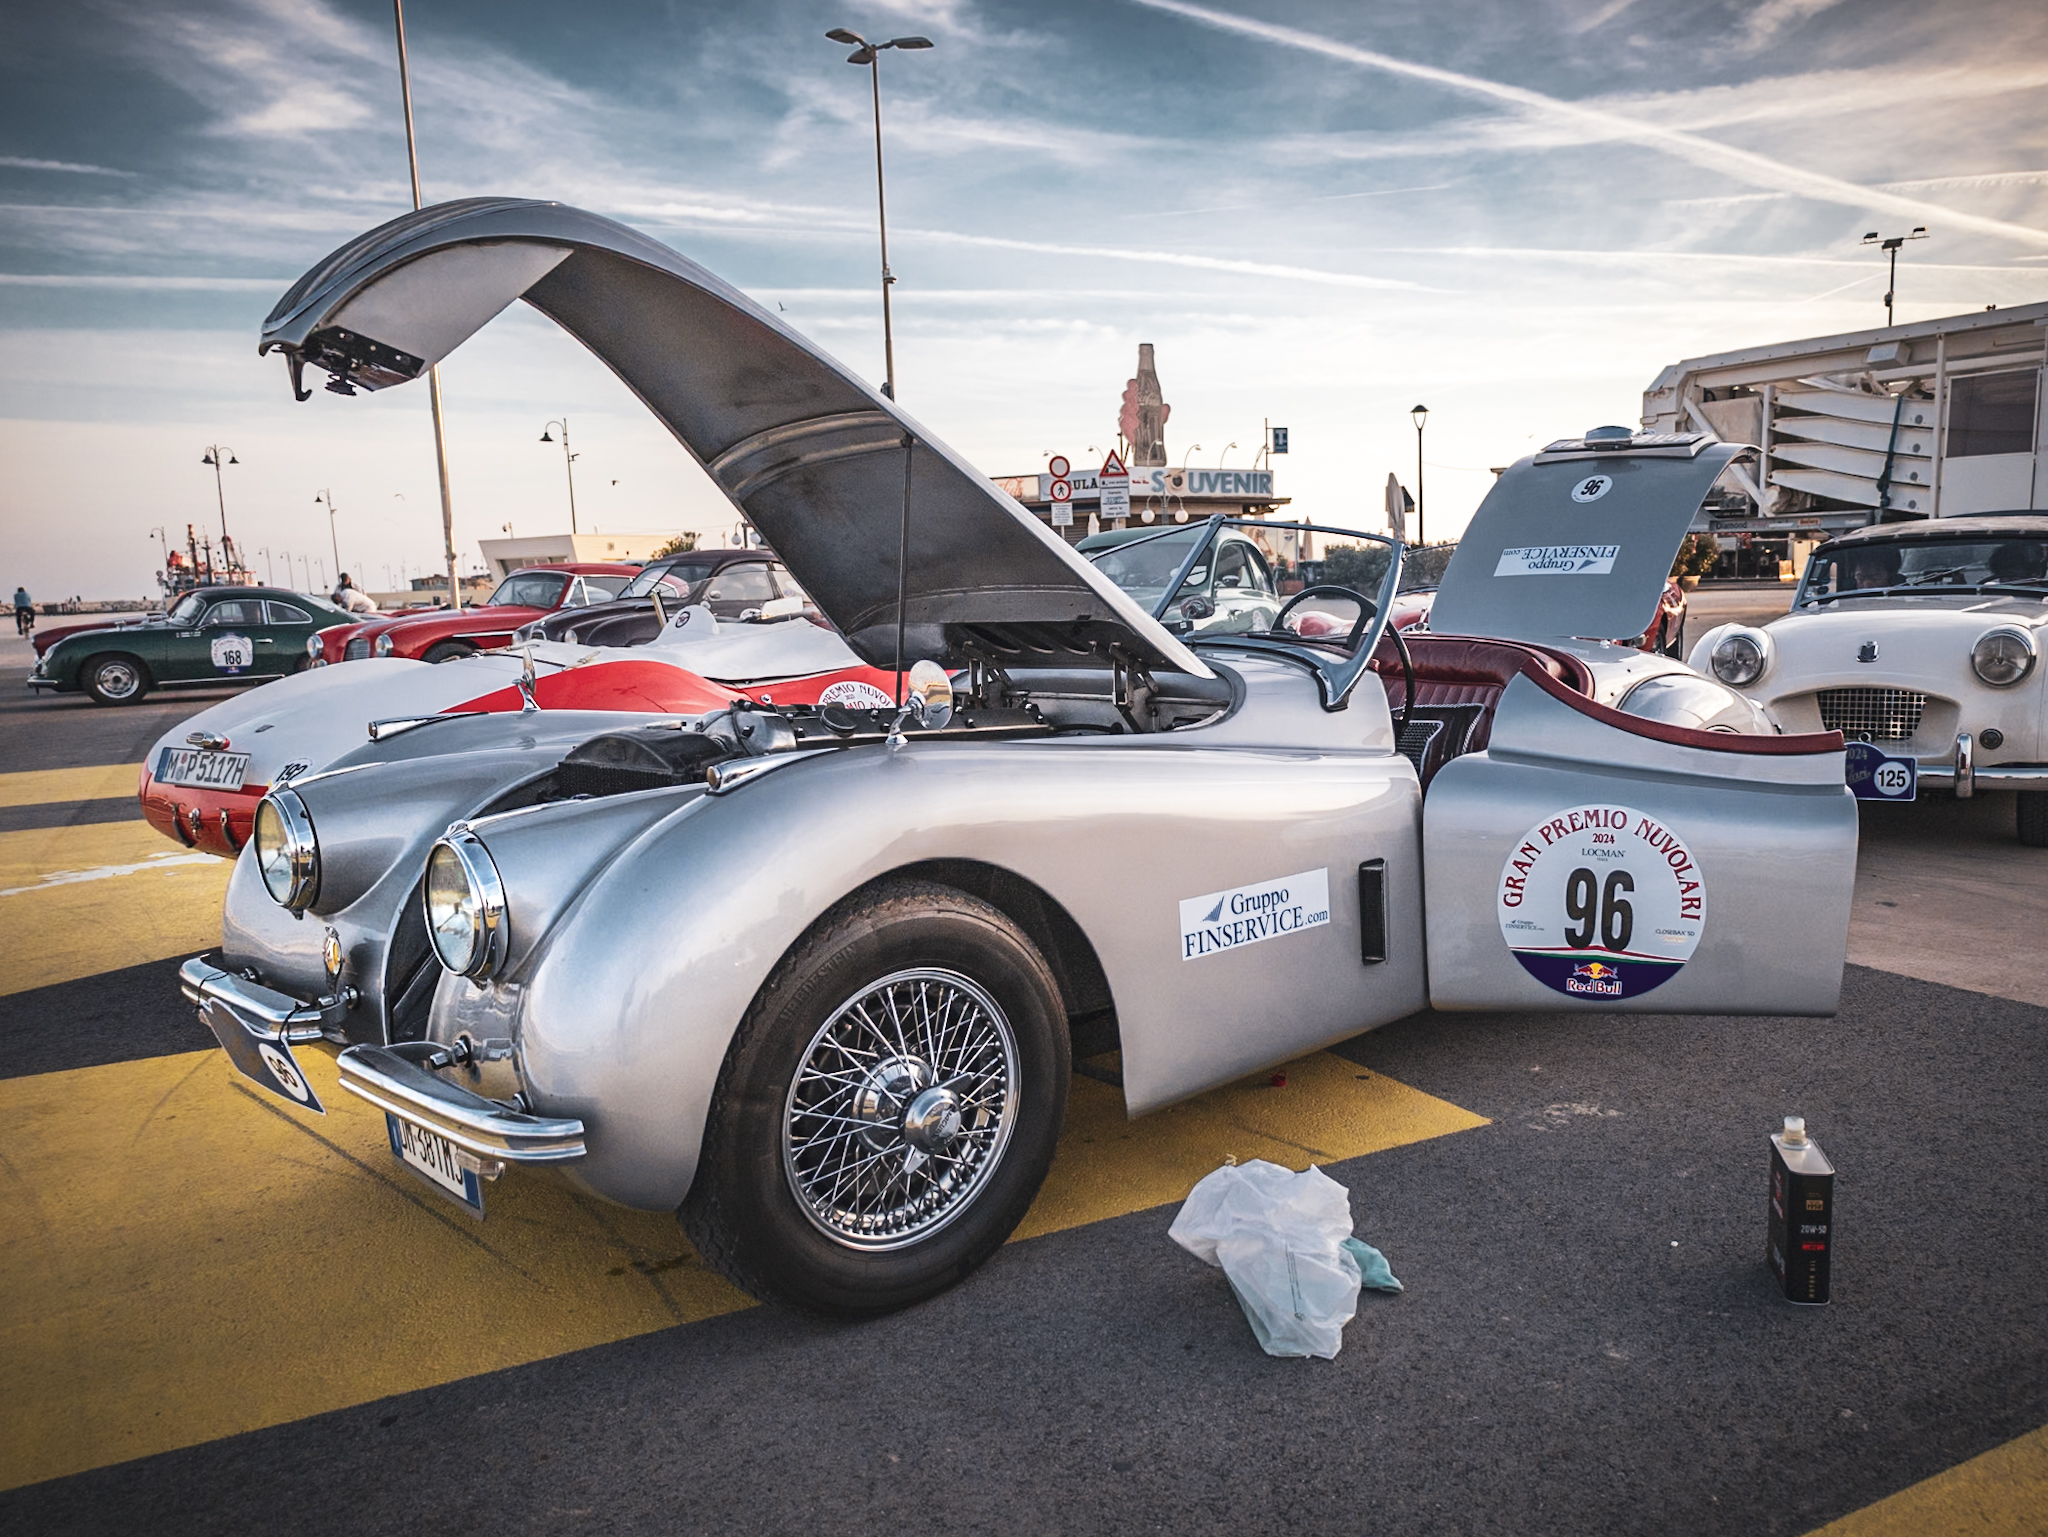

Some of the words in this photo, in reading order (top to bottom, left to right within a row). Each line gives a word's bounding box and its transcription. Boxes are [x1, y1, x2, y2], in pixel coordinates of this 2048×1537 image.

[1151, 470, 1272, 494] SOUVENIR
[1580, 479, 1605, 496] 96
[1528, 559, 1575, 571] Gruppo
[223, 649, 242, 665] 168
[1878, 769, 1906, 788] 125
[1592, 832, 1615, 845] 2024
[1581, 847, 1625, 858] LOCMAN
[1503, 841, 1542, 908] GRAN
[1538, 809, 1628, 846] PREMIO
[1634, 817, 1702, 921] NUVOLARI
[1231, 888, 1289, 915] Gruppo
[1564, 867, 1635, 952] 96
[1566, 978, 1594, 993] Red
[1595, 980, 1622, 995] Bull
[267, 1055, 298, 1089] 96
[1800, 1224, 1827, 1234] 20W-50
